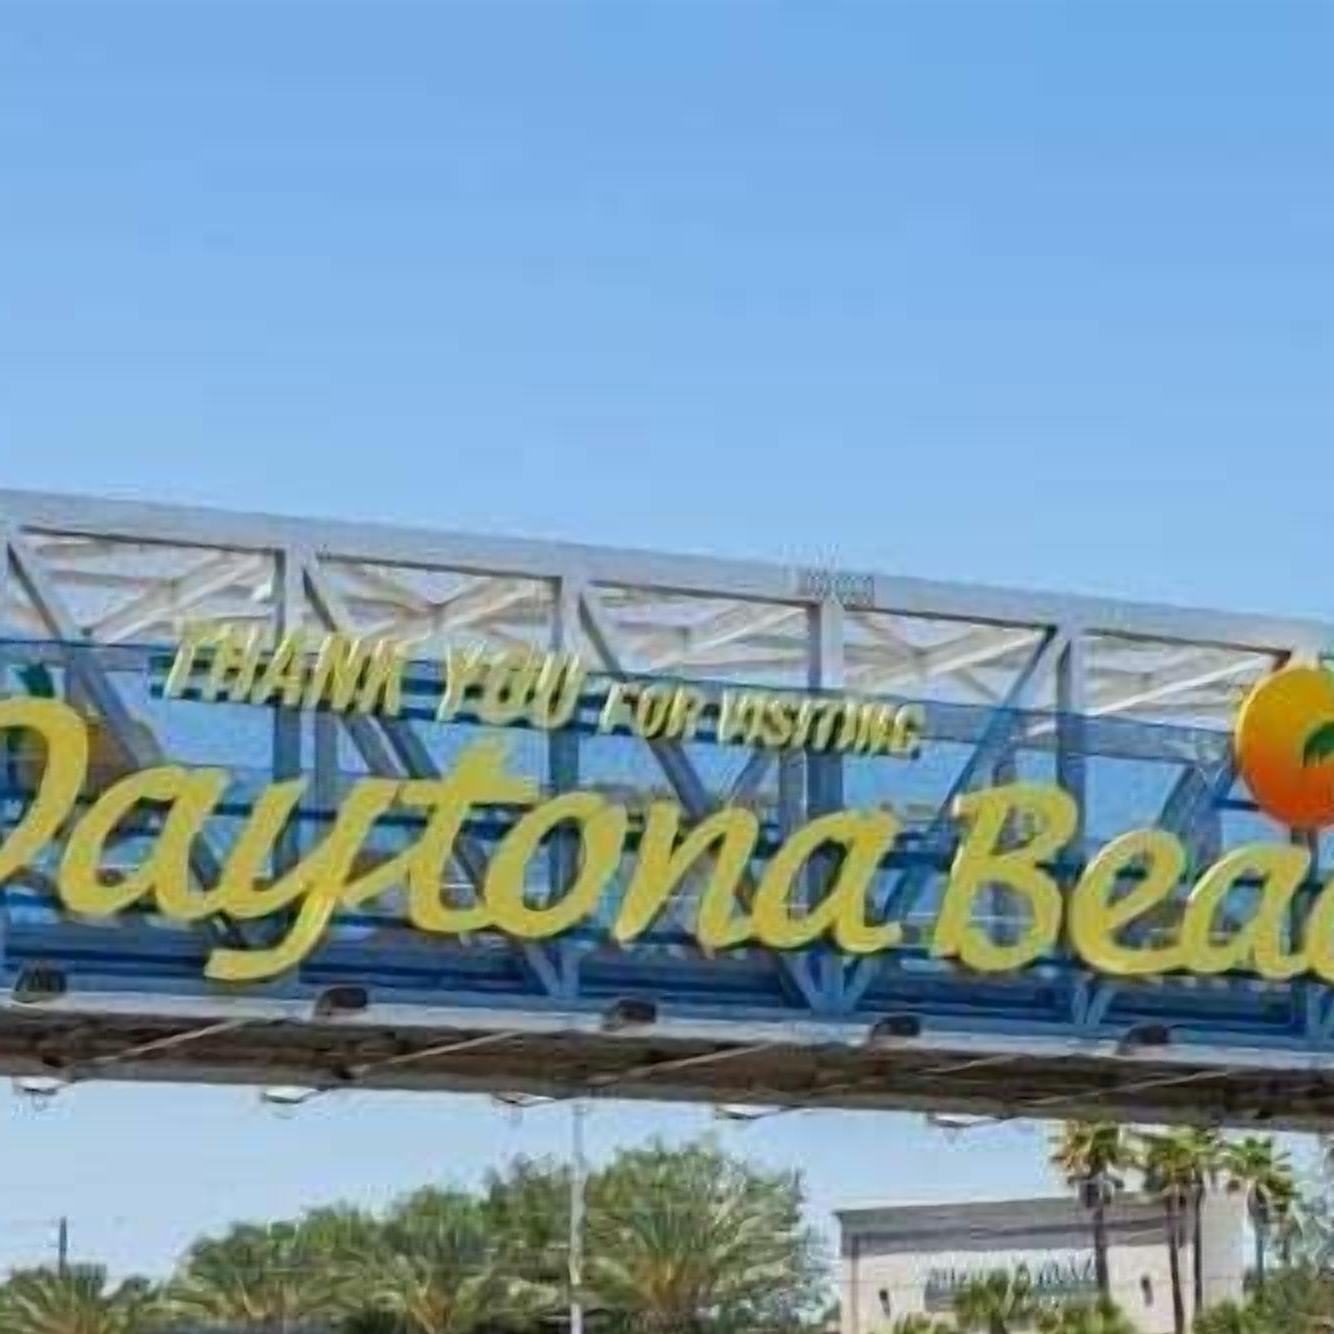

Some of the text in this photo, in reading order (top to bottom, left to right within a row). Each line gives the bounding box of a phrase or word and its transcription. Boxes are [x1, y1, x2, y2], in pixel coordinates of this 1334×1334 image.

[163, 620, 926, 759] THANK YOU FOR VISITING
